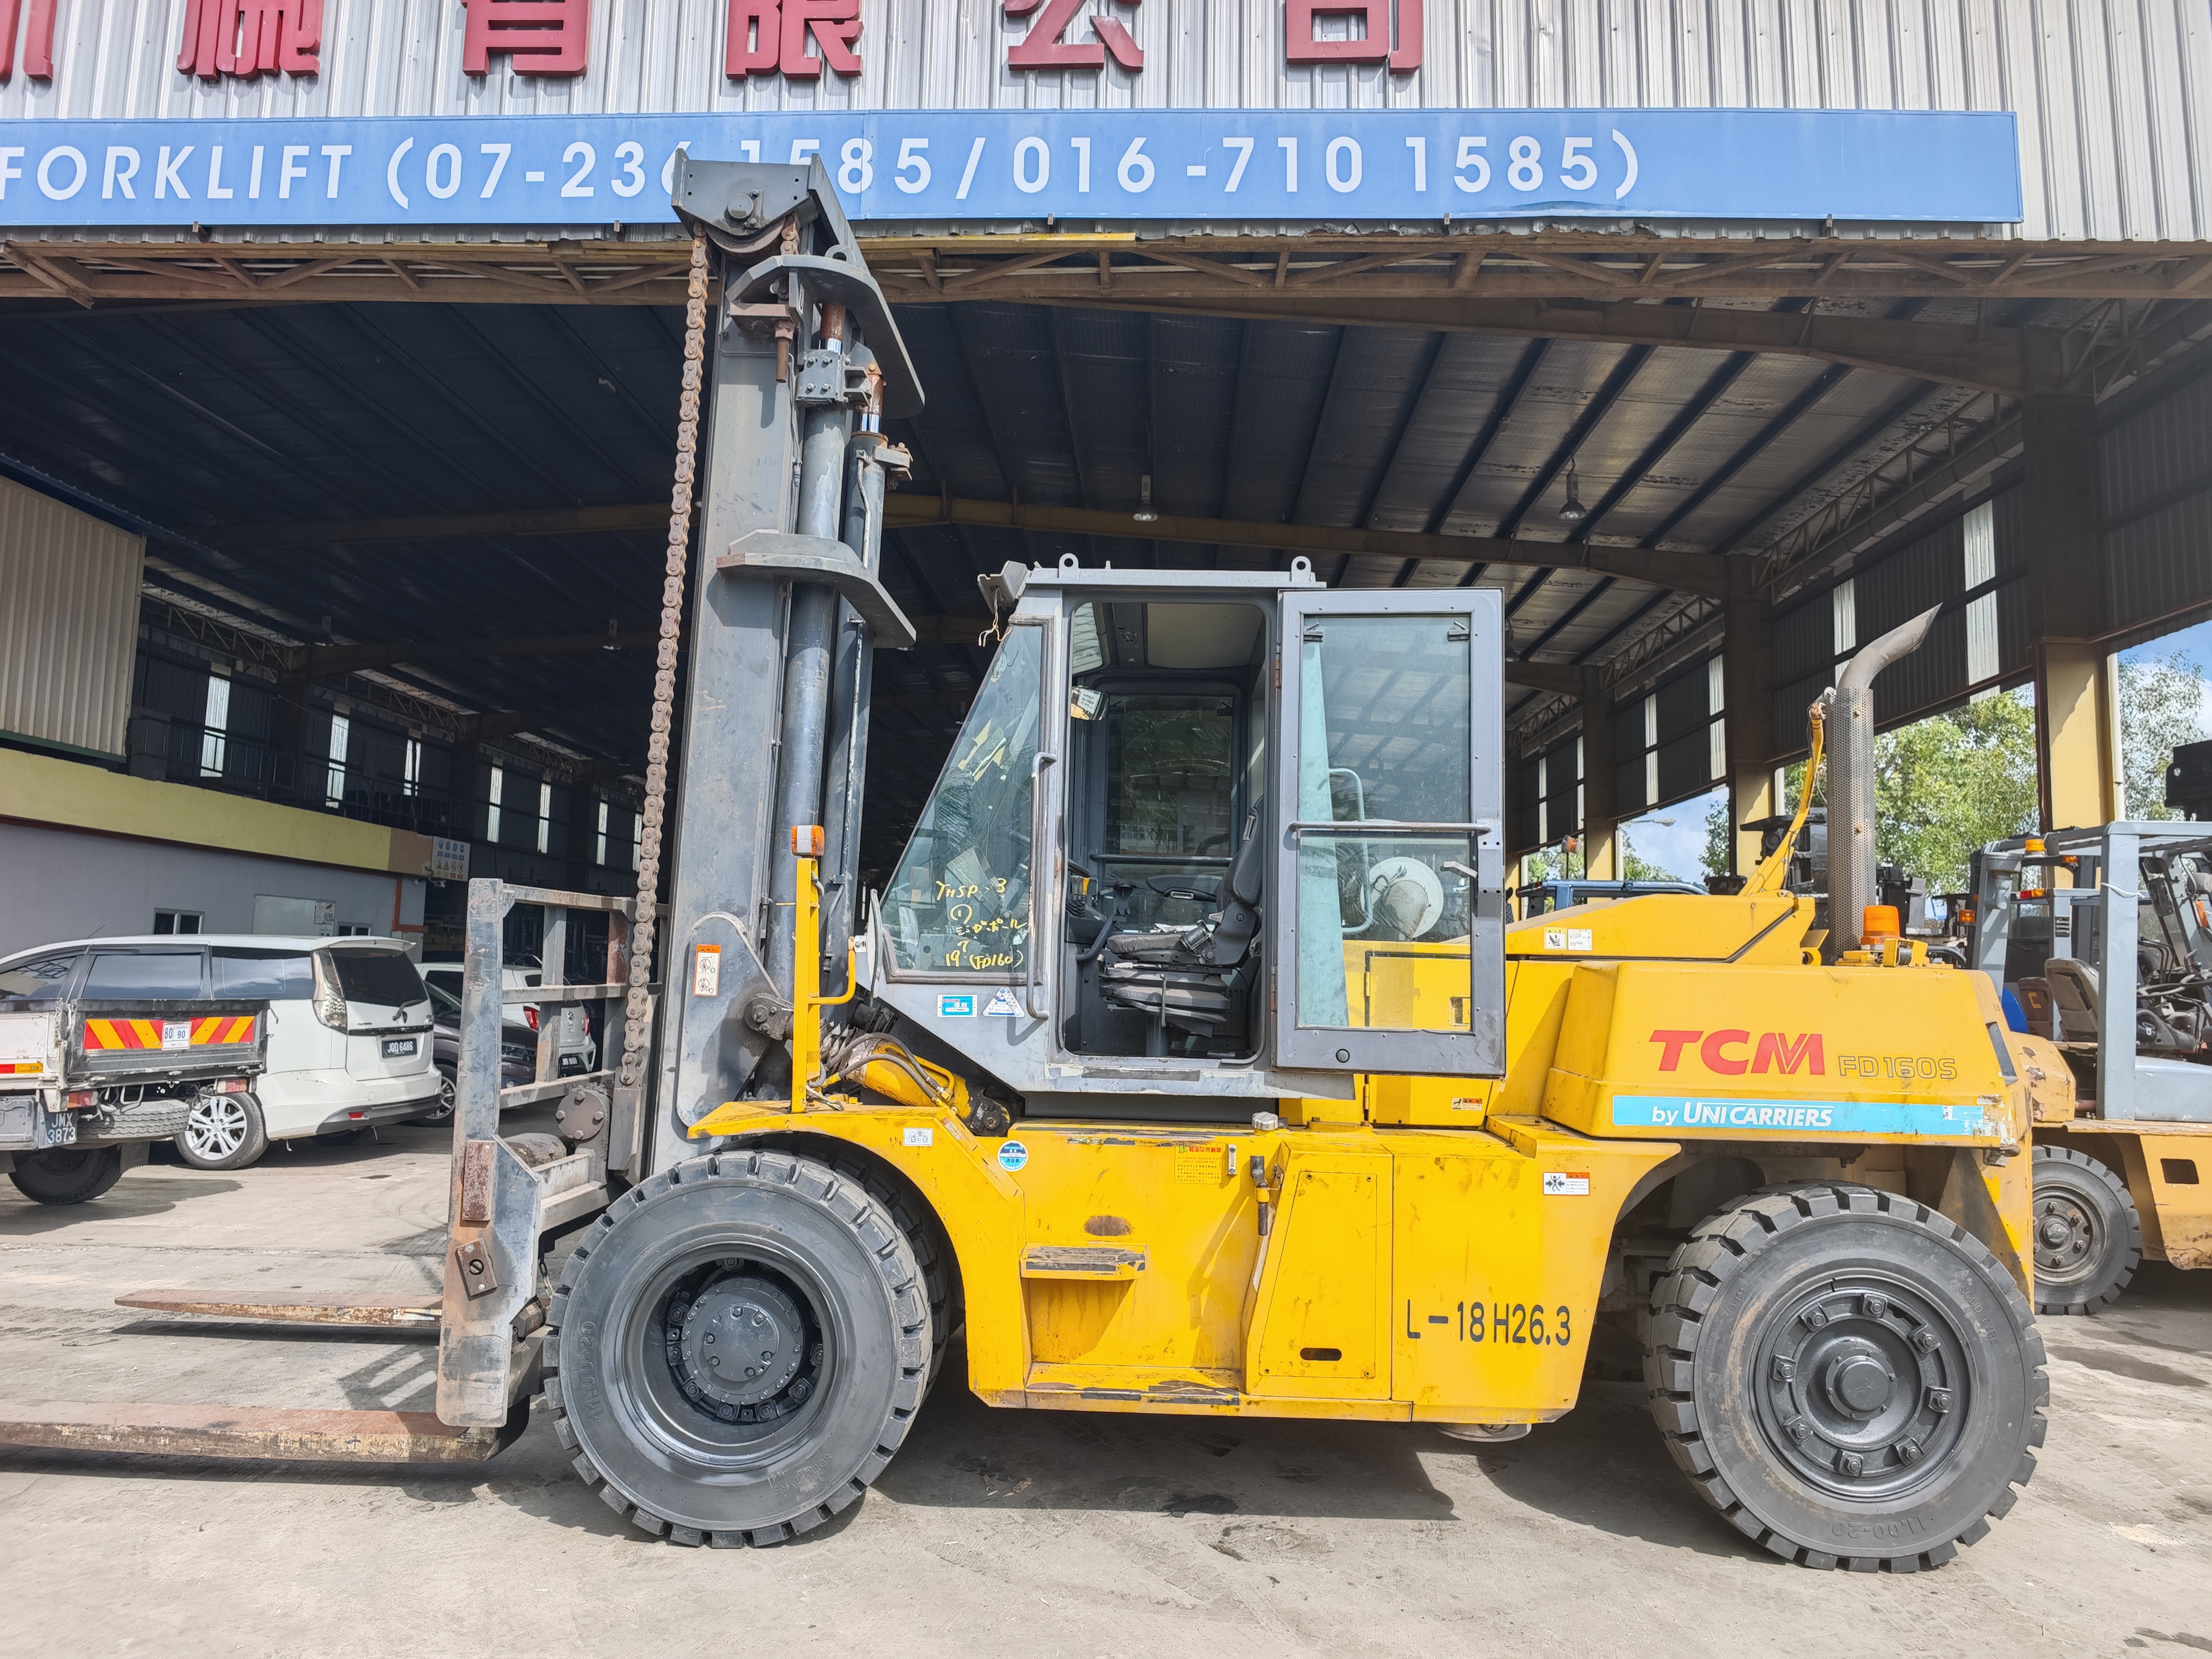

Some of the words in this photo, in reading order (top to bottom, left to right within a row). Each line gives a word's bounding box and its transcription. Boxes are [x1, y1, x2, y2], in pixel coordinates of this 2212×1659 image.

[1406, 128, 1638, 200] 1585)
[164, 1027, 173, 1039] 80
[177, 1030, 186, 1038] 90
[388, 1042, 399, 1053] JQD
[399, 1040, 414, 1052] 6486
[1649, 1029, 1826, 1076] TCM
[51, 1112, 73, 1128] JMX
[1651, 1105, 1679, 1126] by
[48, 1126, 76, 1144] 3873
[1959, 1285, 1983, 1313] SOLID
